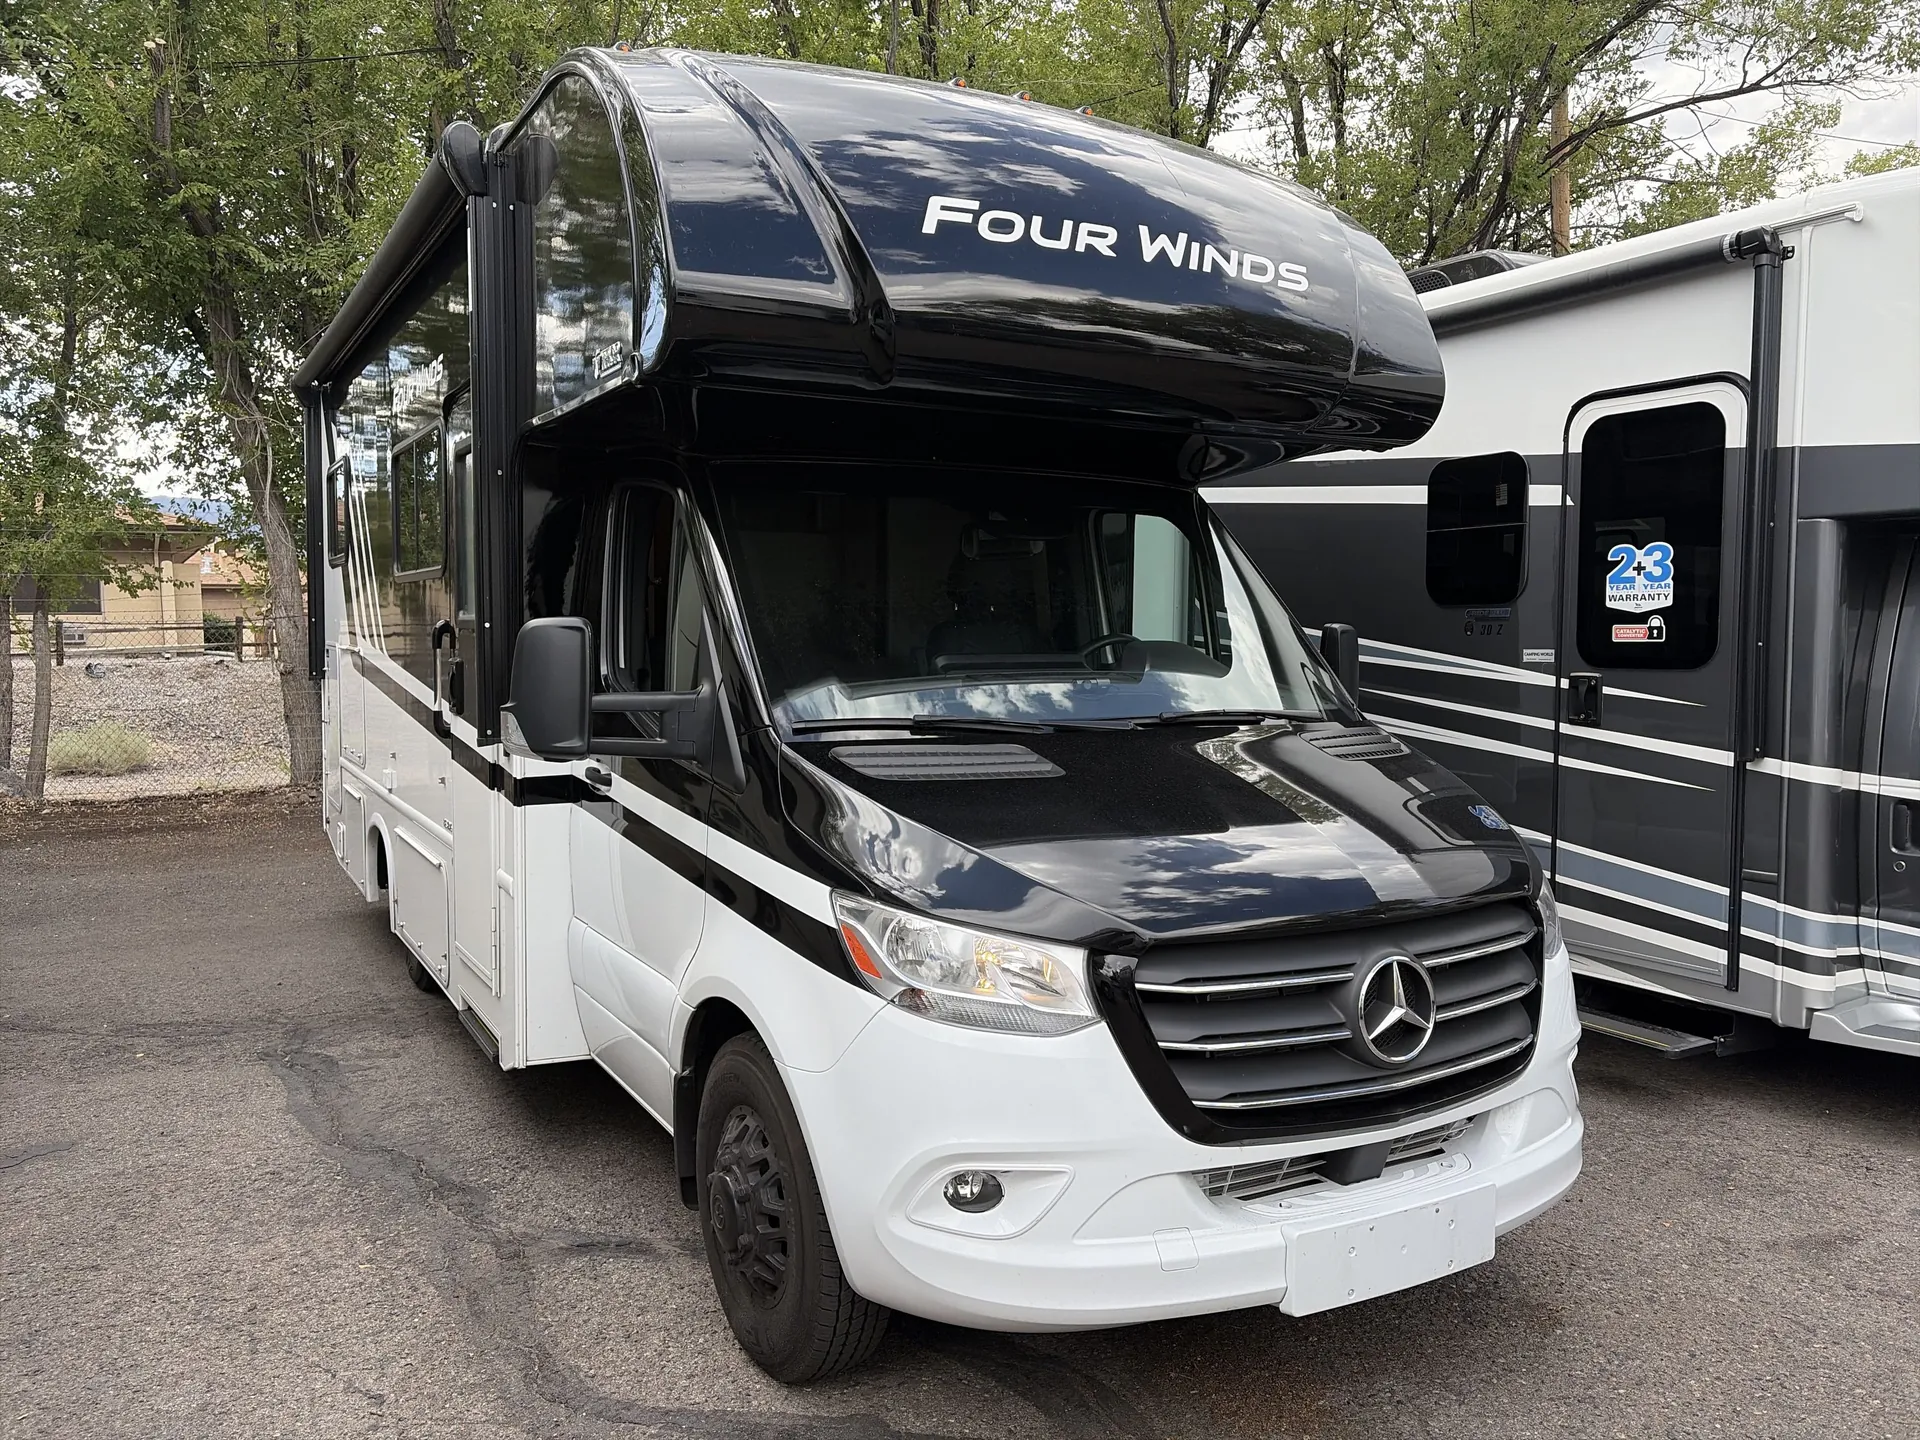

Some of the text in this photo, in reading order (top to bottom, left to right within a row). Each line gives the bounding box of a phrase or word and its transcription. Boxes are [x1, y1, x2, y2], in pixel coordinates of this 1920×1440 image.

[921, 195, 1310, 292] FOUR WINDS
[1642, 582, 1671, 590] YEAR
[1608, 592, 1671, 602] WARRANTY
